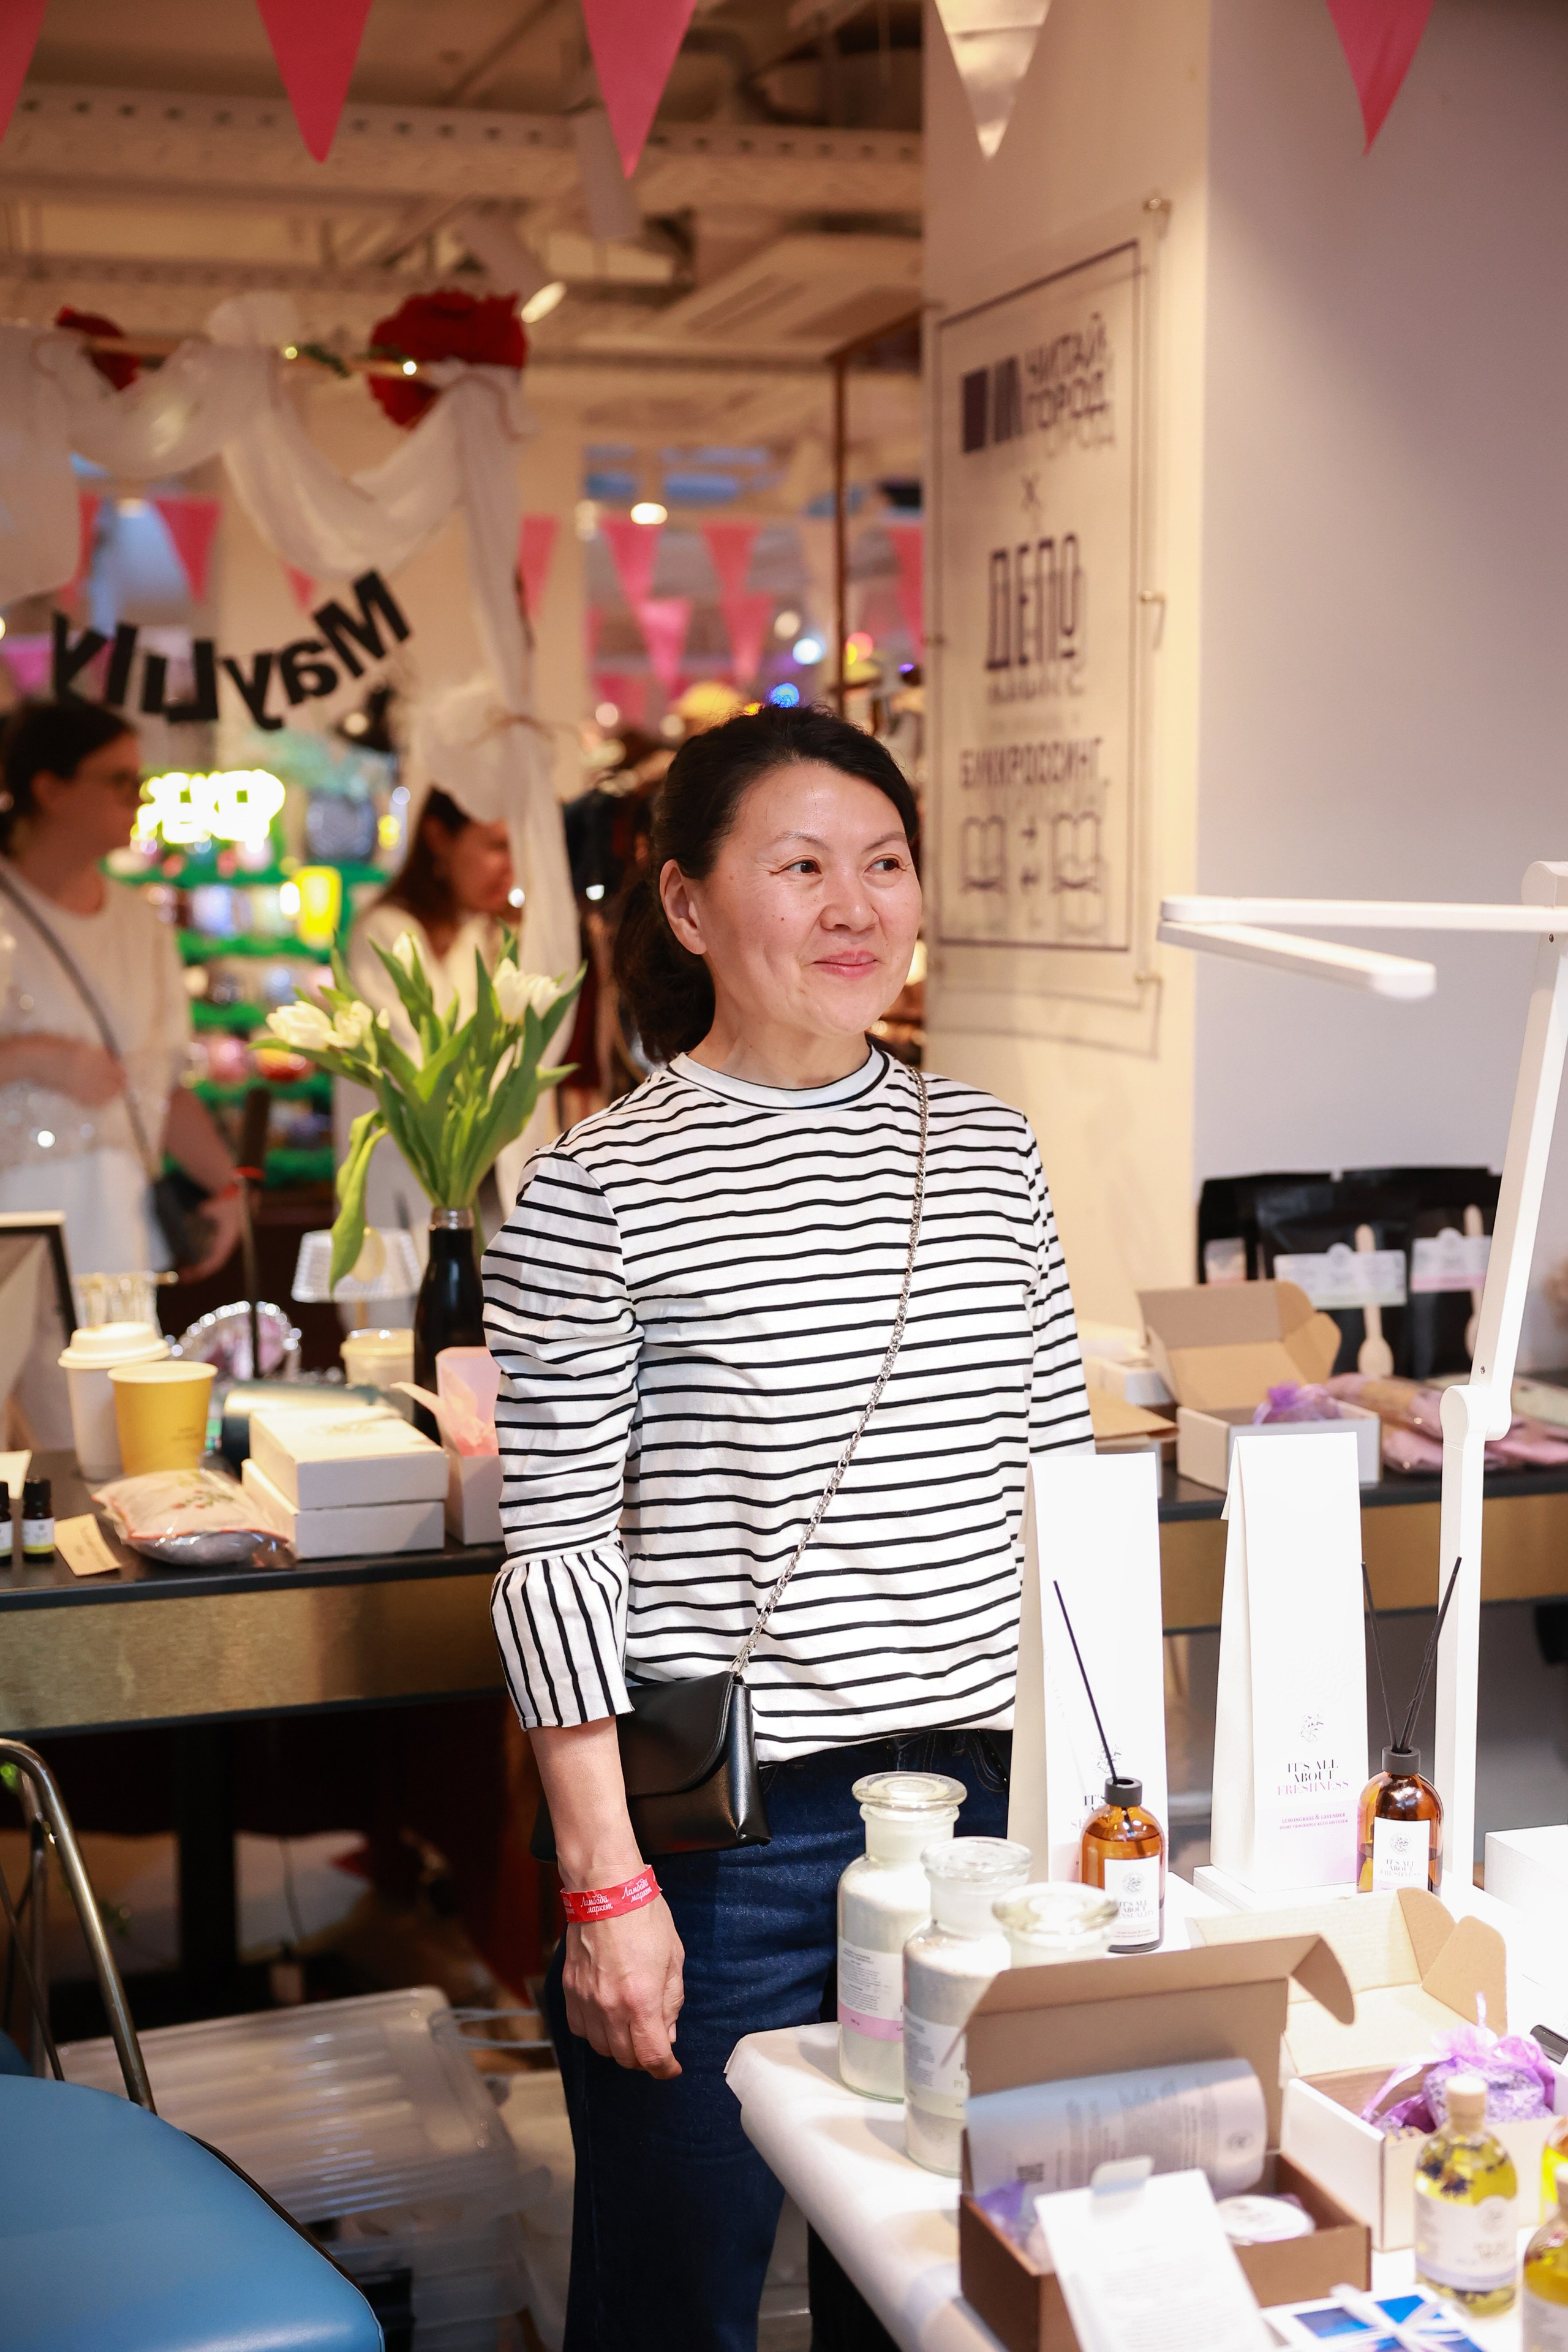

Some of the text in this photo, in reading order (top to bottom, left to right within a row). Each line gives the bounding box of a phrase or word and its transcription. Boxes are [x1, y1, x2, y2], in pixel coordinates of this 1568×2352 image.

[1287, 1758, 1339, 1773] IT'S ALL
[1293, 1770, 1335, 1783] ABOUT
[1278, 1779, 1349, 1795] FRESHNESS
[1281, 1815, 1314, 1823] LEMONGRASS
[621, 1877, 649, 1899] Ламбада
[630, 1885, 652, 1903] маркет
[580, 1893, 609, 1908] Ламбада
[586, 1902, 613, 1915] маркет
